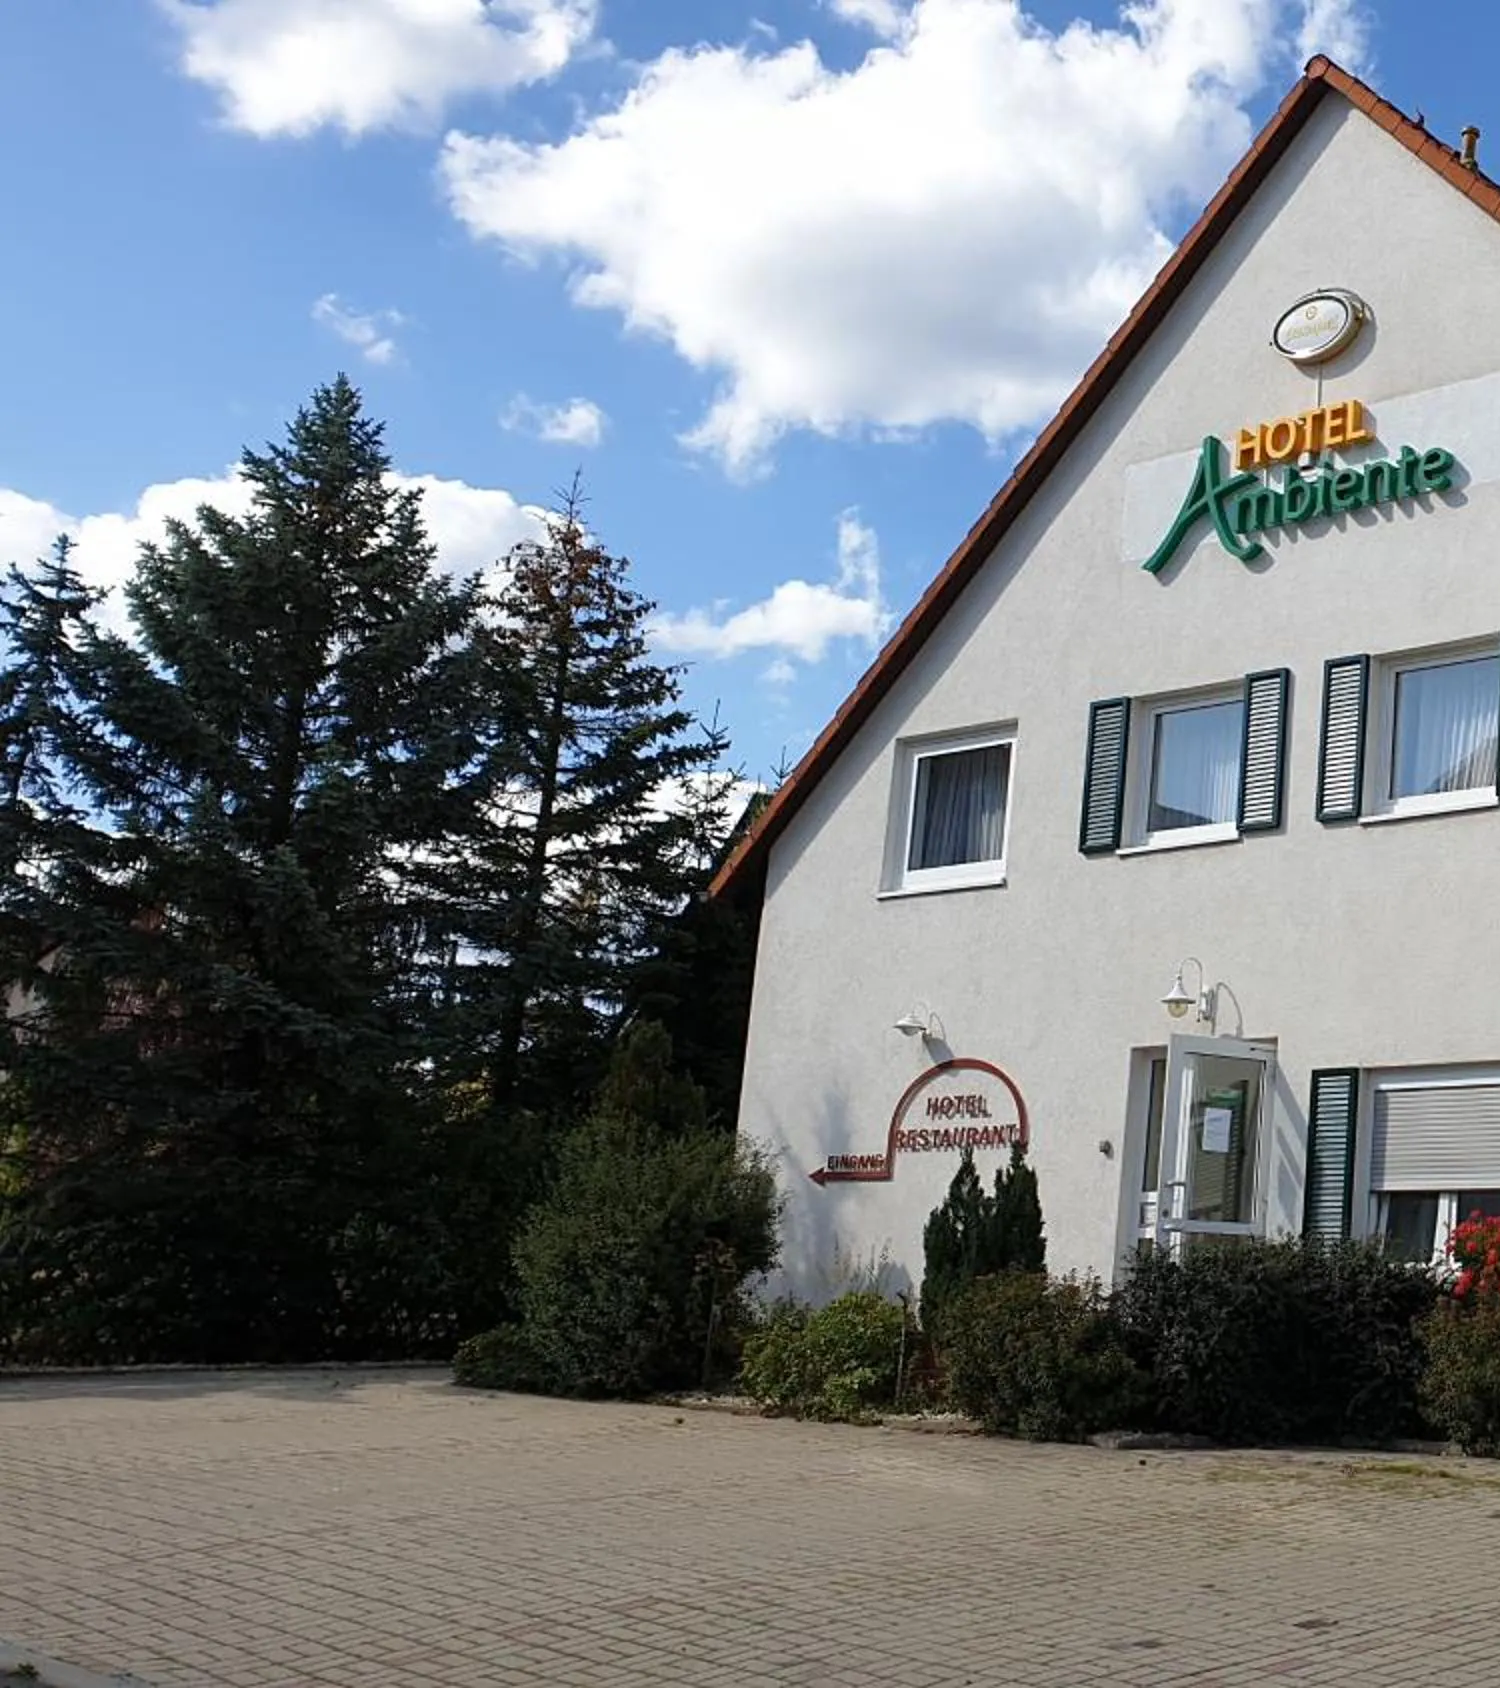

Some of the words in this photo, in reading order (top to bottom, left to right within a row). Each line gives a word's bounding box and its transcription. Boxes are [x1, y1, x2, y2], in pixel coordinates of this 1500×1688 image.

[1234, 399, 1374, 471] HOTEL
[1141, 435, 1455, 574] Ambiente
[926, 1095, 989, 1118] HOTEL
[896, 1123, 1018, 1150] RESTAURANT
[827, 1153, 885, 1170] EINGANG
